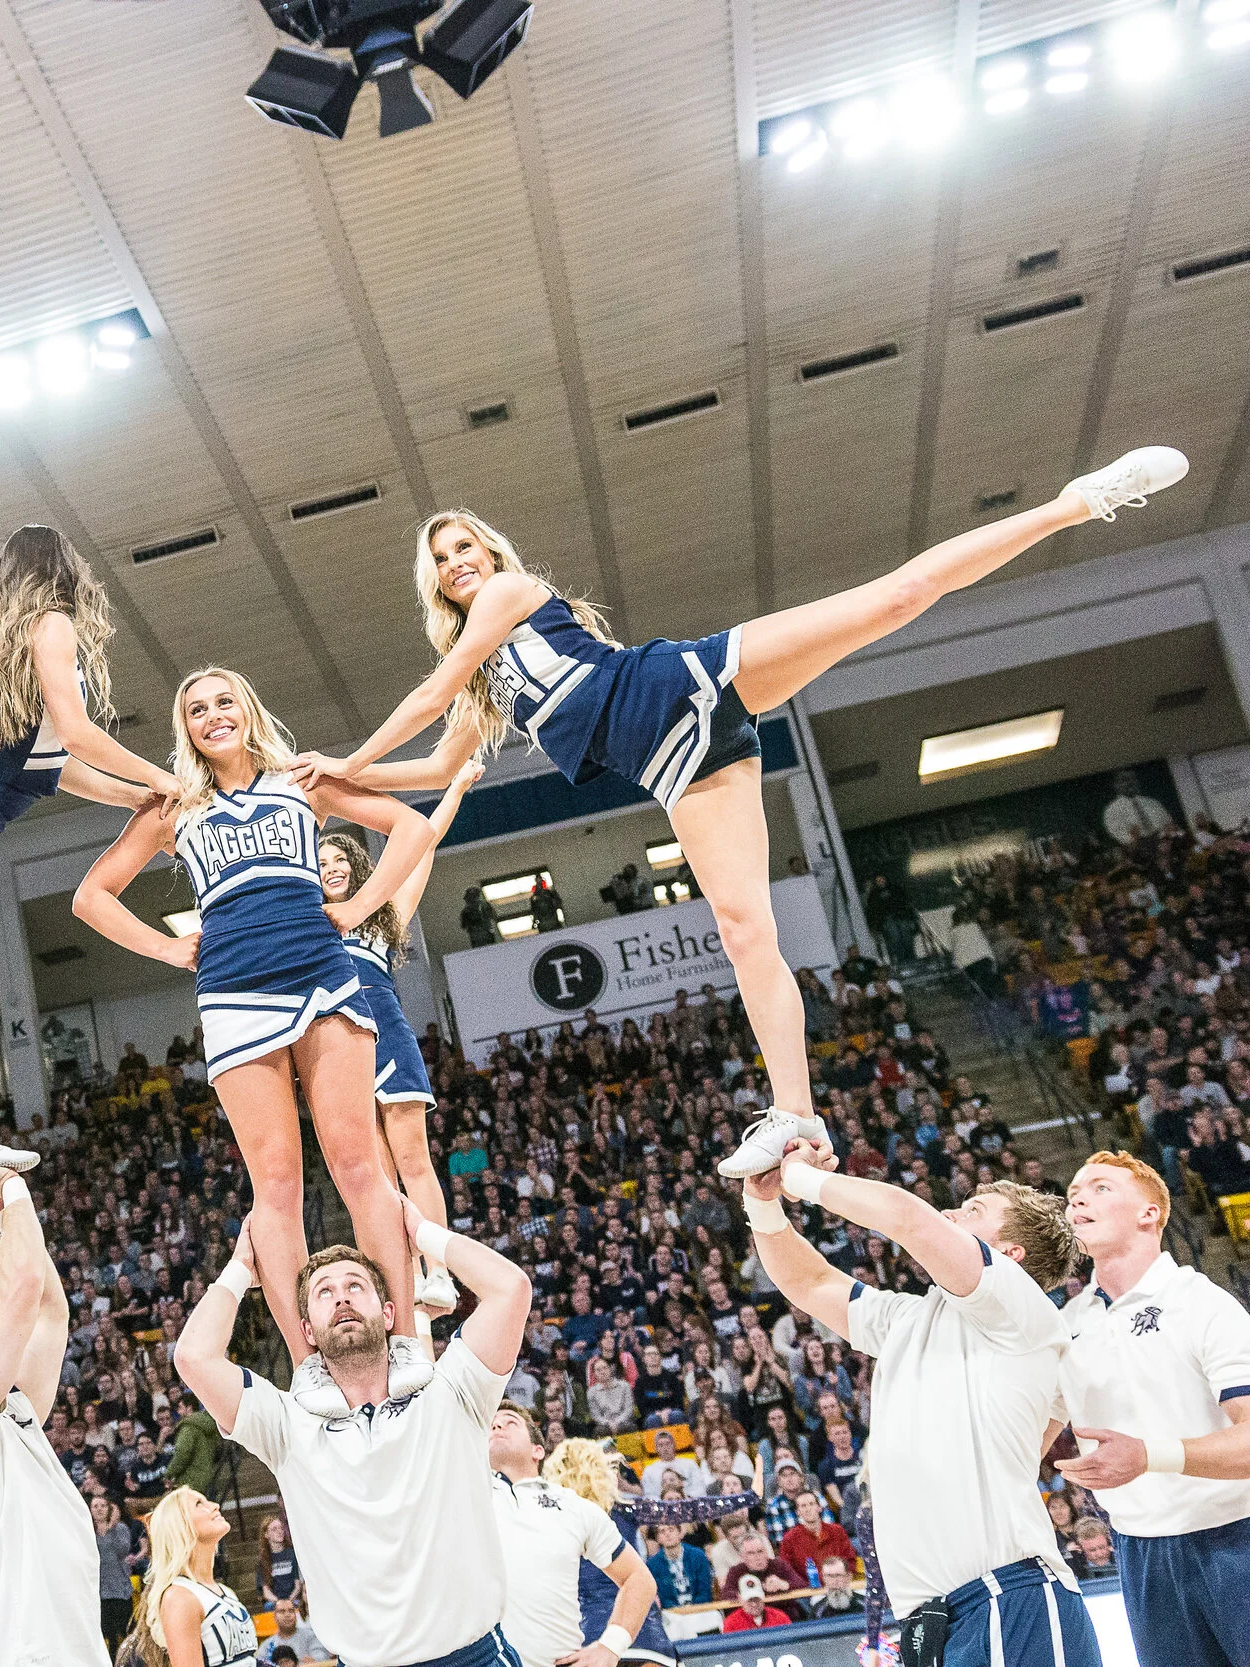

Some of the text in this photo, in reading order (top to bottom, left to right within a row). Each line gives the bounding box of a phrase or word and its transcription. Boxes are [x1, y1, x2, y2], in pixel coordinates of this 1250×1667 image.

[199, 807, 298, 878] AGGIES
[613, 924, 723, 972] Fishe
[550, 954, 583, 1000] F
[616, 956, 732, 991] Home Furnishi
[11, 1018, 28, 1039] K
